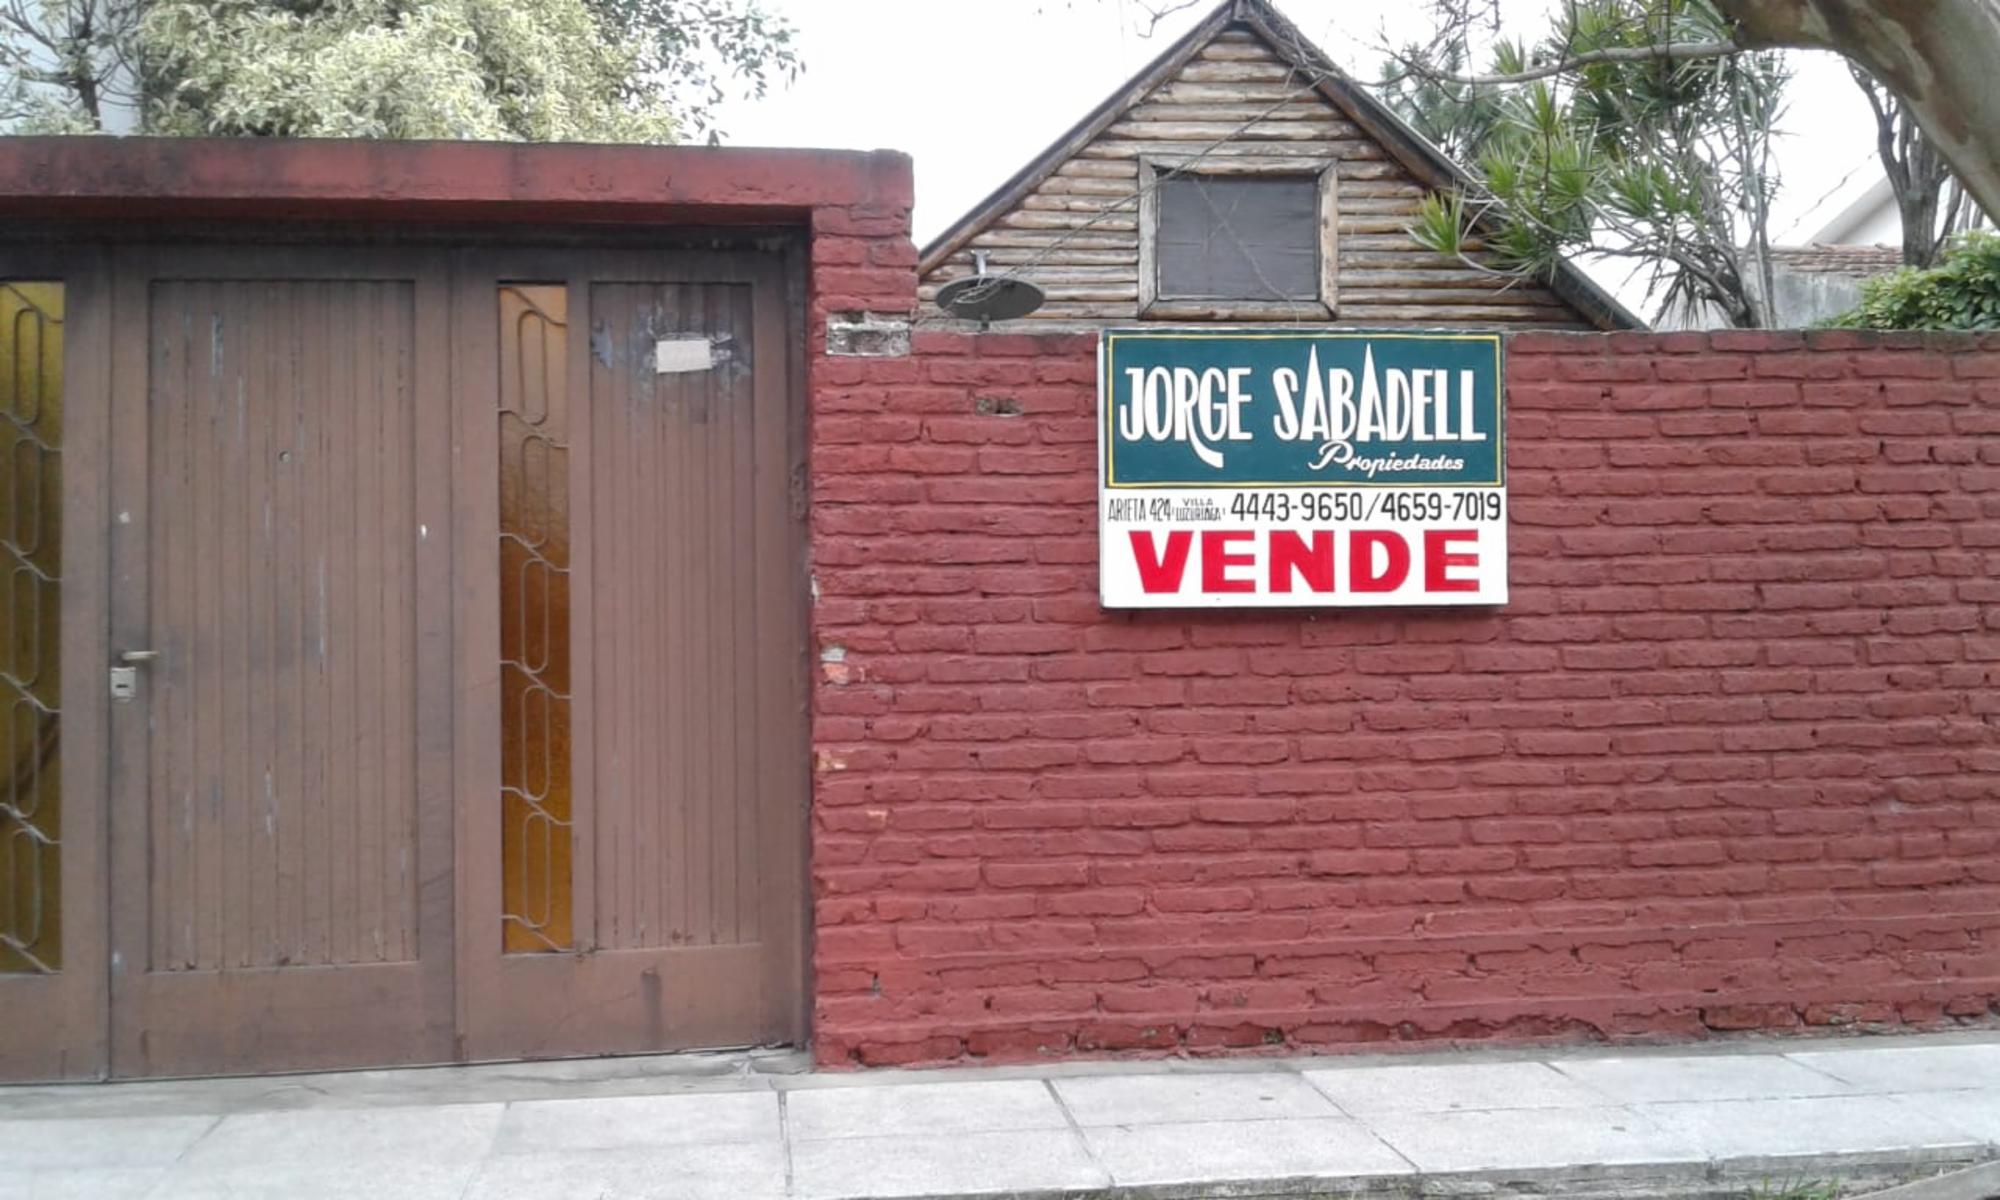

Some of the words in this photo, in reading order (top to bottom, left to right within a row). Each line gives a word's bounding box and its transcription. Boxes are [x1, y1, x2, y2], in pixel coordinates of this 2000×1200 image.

[1119, 366, 1253, 469] JORGE
[1272, 342, 1487, 442] SABADELL
[1307, 440, 1464, 478] Propiedades
[1107, 498, 1147, 522] ARIETA
[1149, 497, 1171, 522] 424
[1181, 497, 1214, 507] VILLA
[1128, 528, 1480, 594] VENDE
